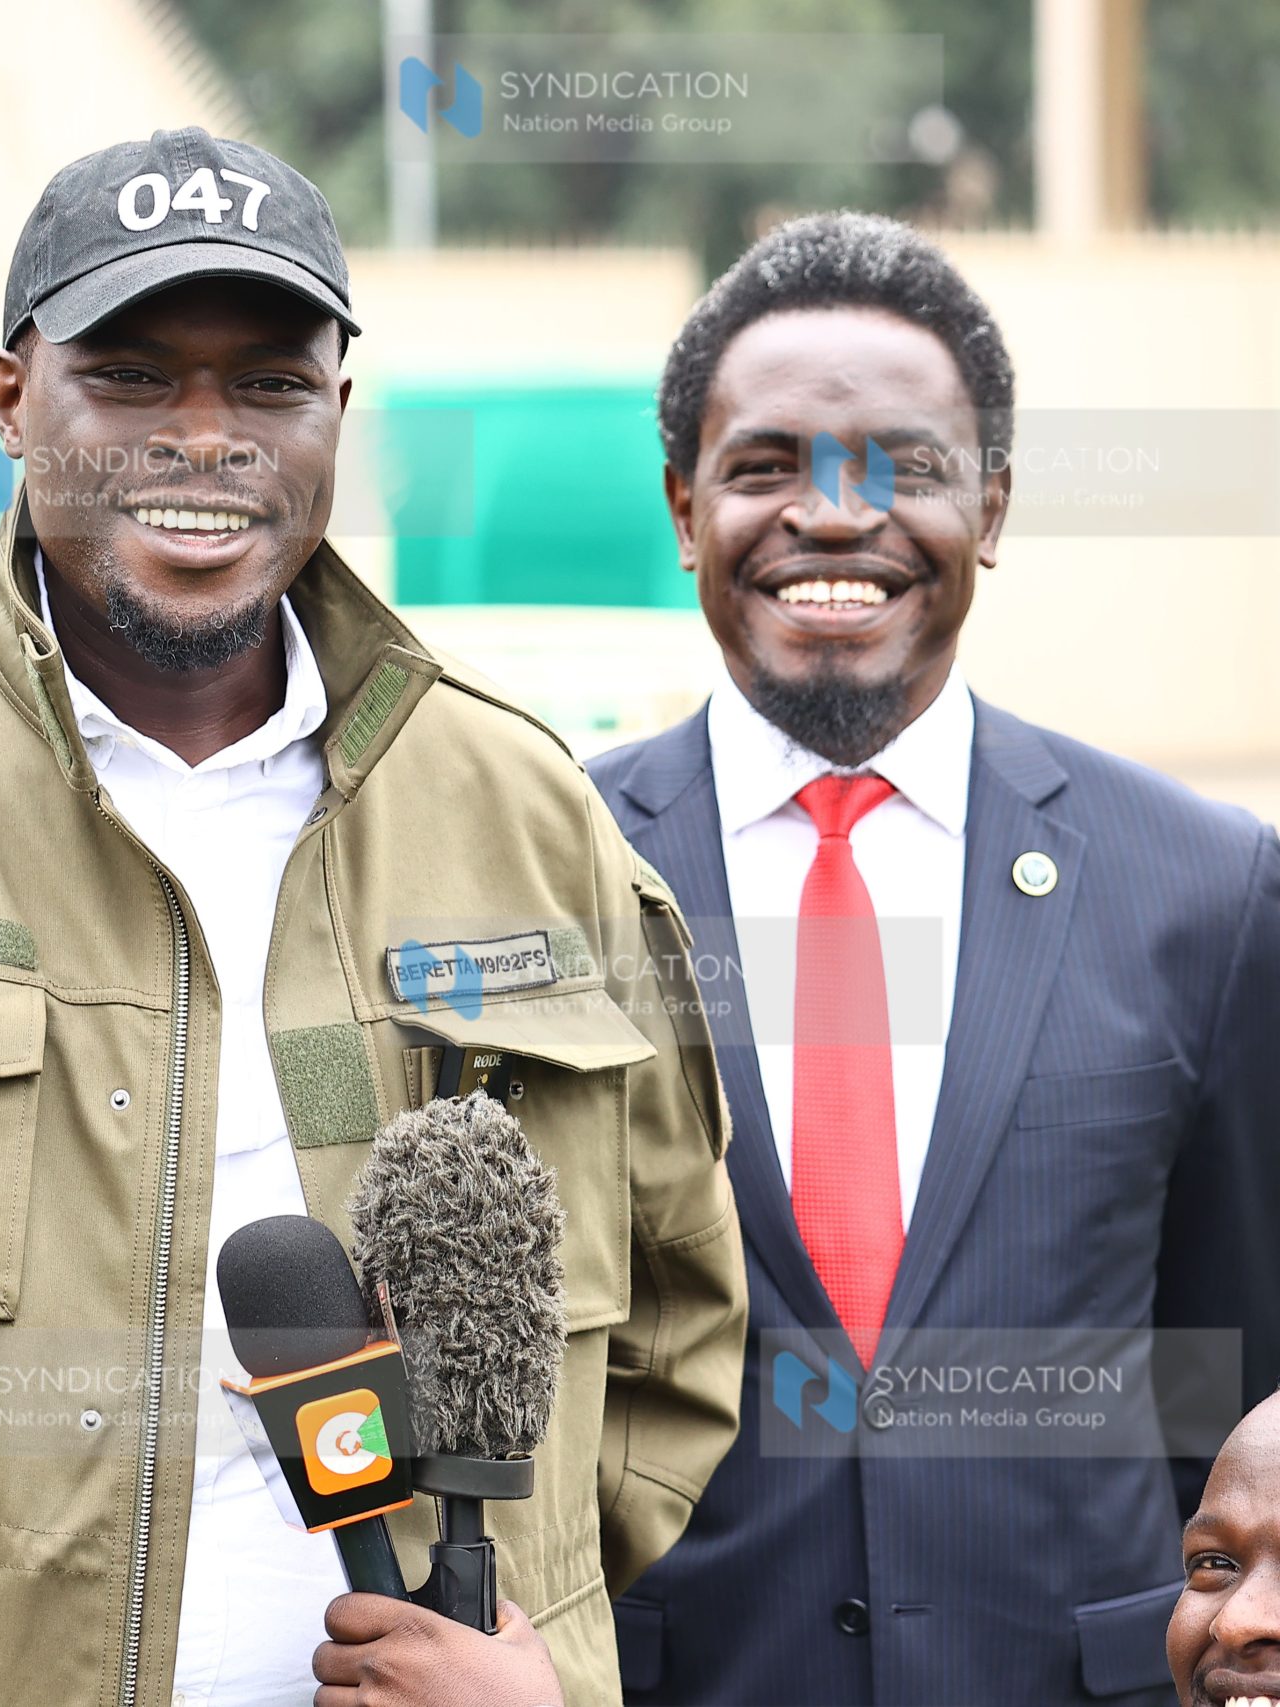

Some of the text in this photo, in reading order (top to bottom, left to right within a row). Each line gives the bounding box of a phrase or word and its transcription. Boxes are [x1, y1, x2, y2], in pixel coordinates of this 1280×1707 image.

[118, 167, 271, 232] 047
[395, 949, 547, 983] BERETTA M9/92FS
[473, 1053, 503, 1069] RØDE
